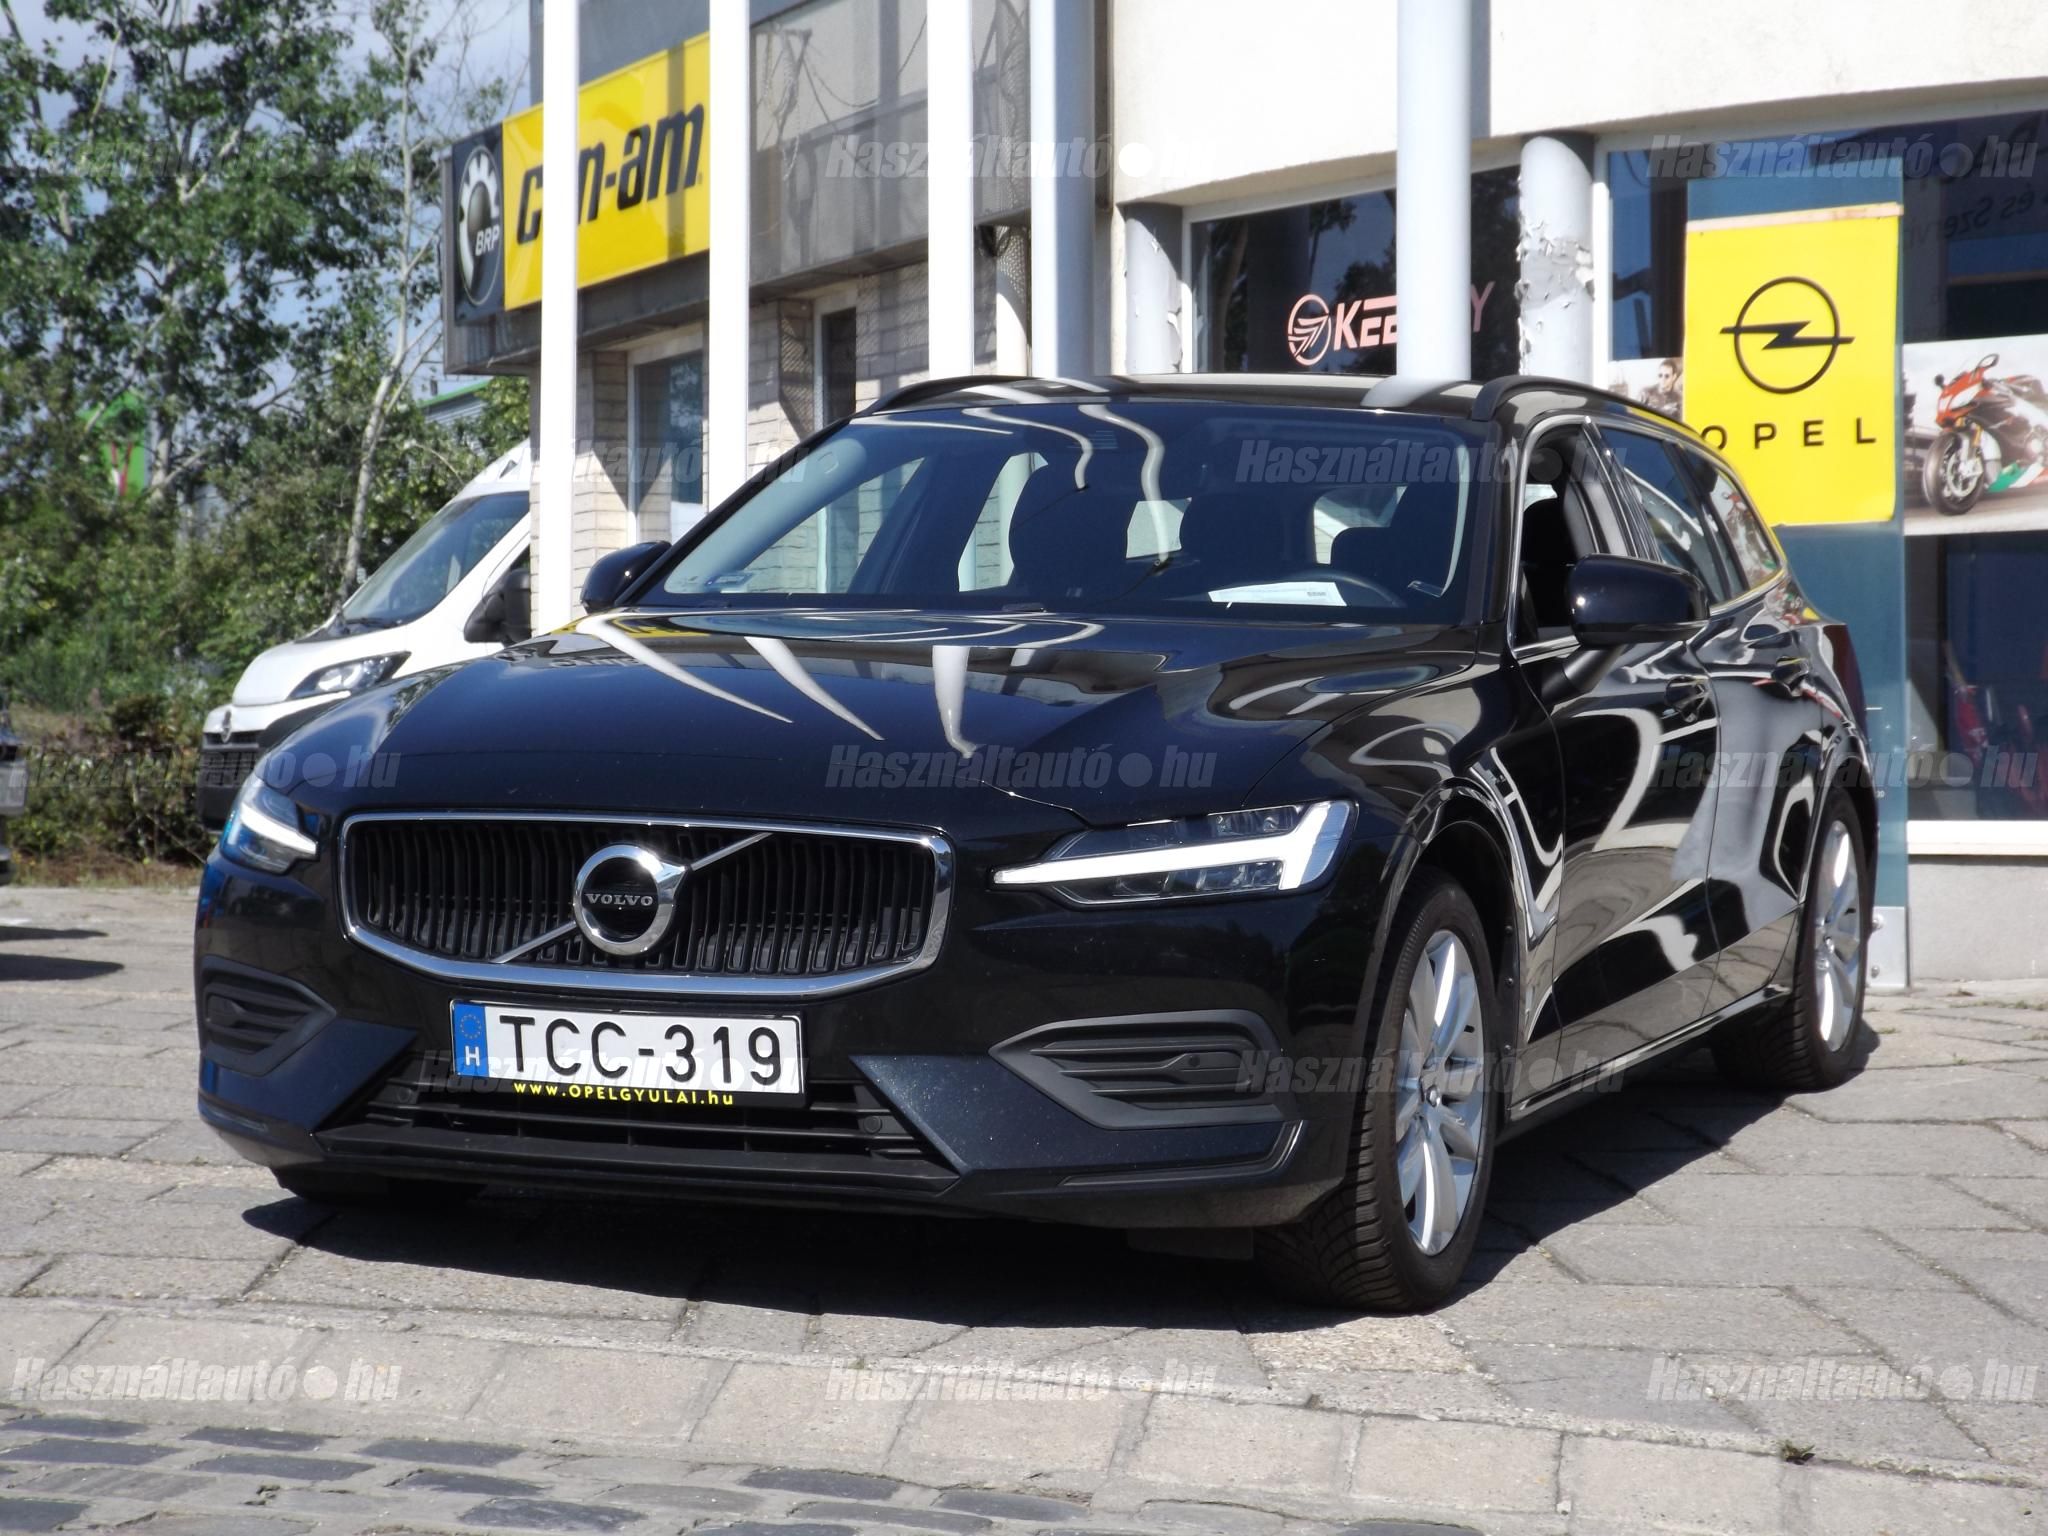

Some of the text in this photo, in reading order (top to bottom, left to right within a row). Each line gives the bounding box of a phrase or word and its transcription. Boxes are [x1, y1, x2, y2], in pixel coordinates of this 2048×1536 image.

[516, 103, 705, 245] cn-am
[475, 225, 500, 256] BRP
[1333, 281, 1496, 351] KEEY
[1701, 416, 1876, 451] OPEL
[585, 893, 654, 906] VOLVO
[465, 1015, 781, 1086] H TCC-319
